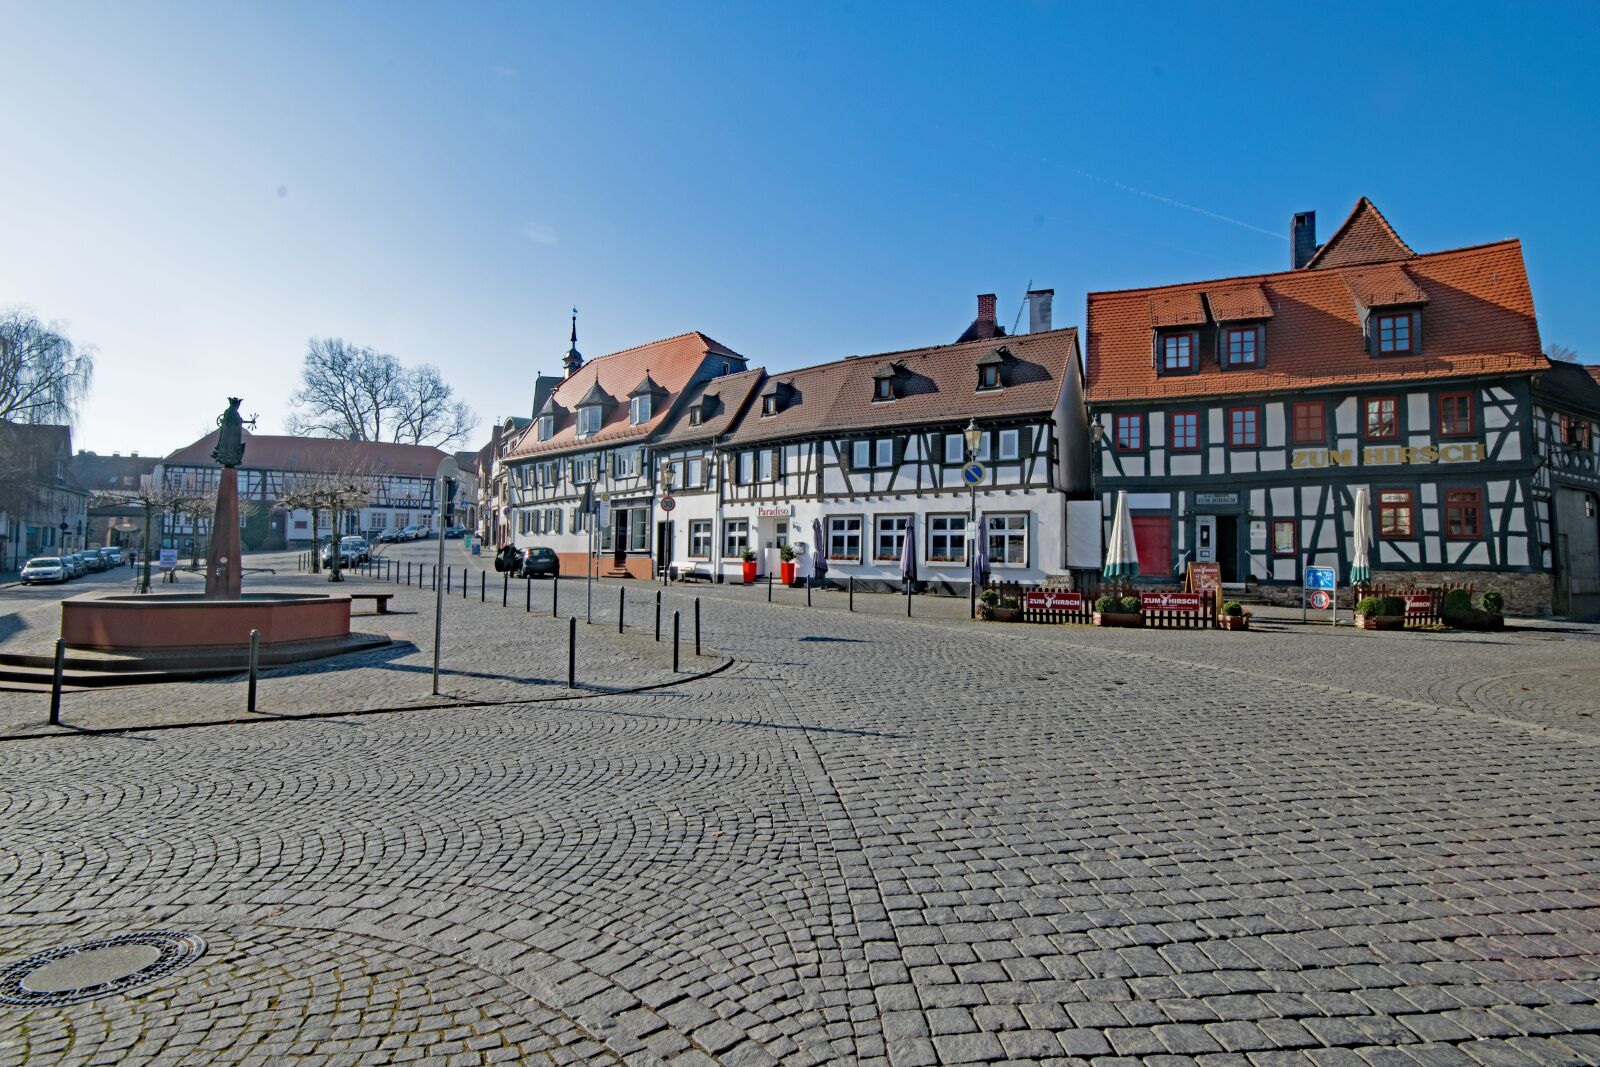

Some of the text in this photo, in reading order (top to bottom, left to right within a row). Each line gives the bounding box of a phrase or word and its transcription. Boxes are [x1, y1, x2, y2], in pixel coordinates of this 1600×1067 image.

[1291, 443, 1486, 468] ZUM HIRSCH
[663, 500, 673, 508] 30
[757, 506, 789, 517] Paradiso
[1052, 599, 1080, 607] HIRSCH
